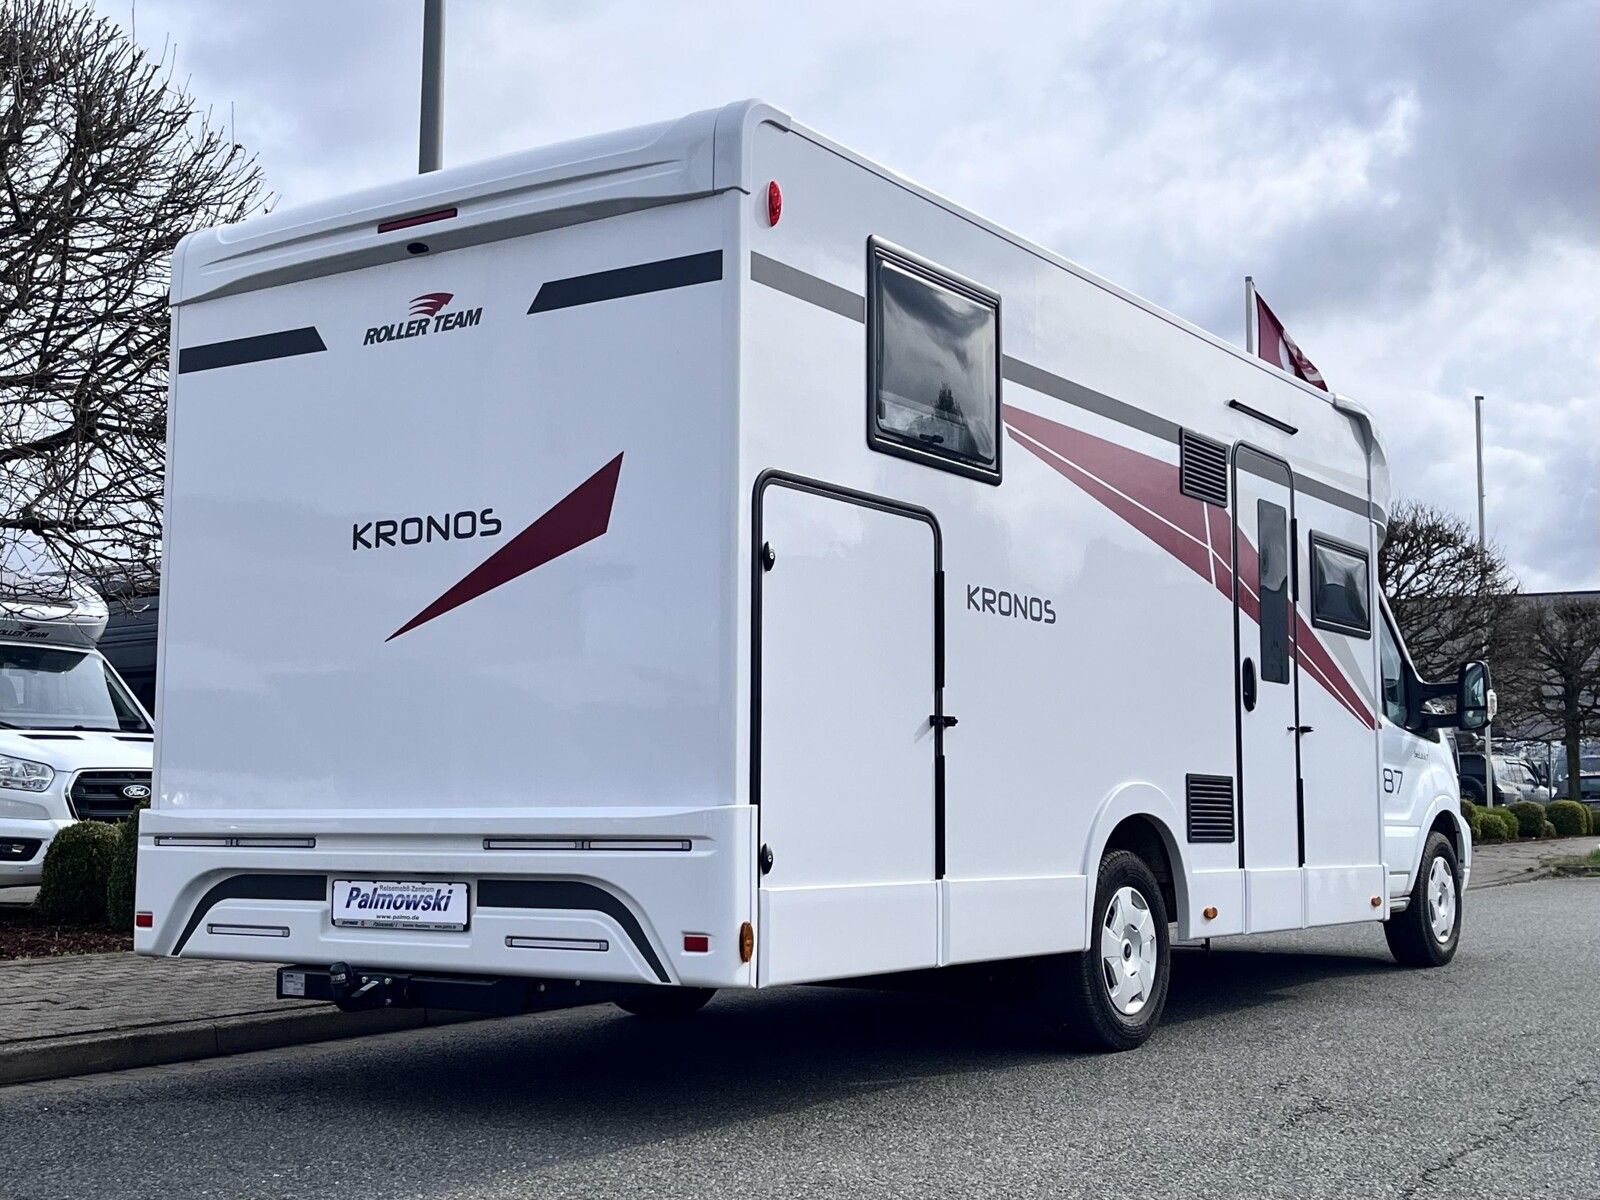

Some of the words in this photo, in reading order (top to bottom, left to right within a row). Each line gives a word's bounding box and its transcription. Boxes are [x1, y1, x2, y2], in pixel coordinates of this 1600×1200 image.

[363, 318, 431, 346] ROLLER
[433, 307, 483, 333] TEAM
[353, 508, 502, 551] KRONOS
[967, 584, 1056, 624] KRONOS
[0, 629, 25, 638] OLLER
[25, 631, 50, 639] TEAM
[128, 784, 146, 796] Ford
[1383, 768, 1403, 795] 87
[345, 887, 453, 912] Palmowski
